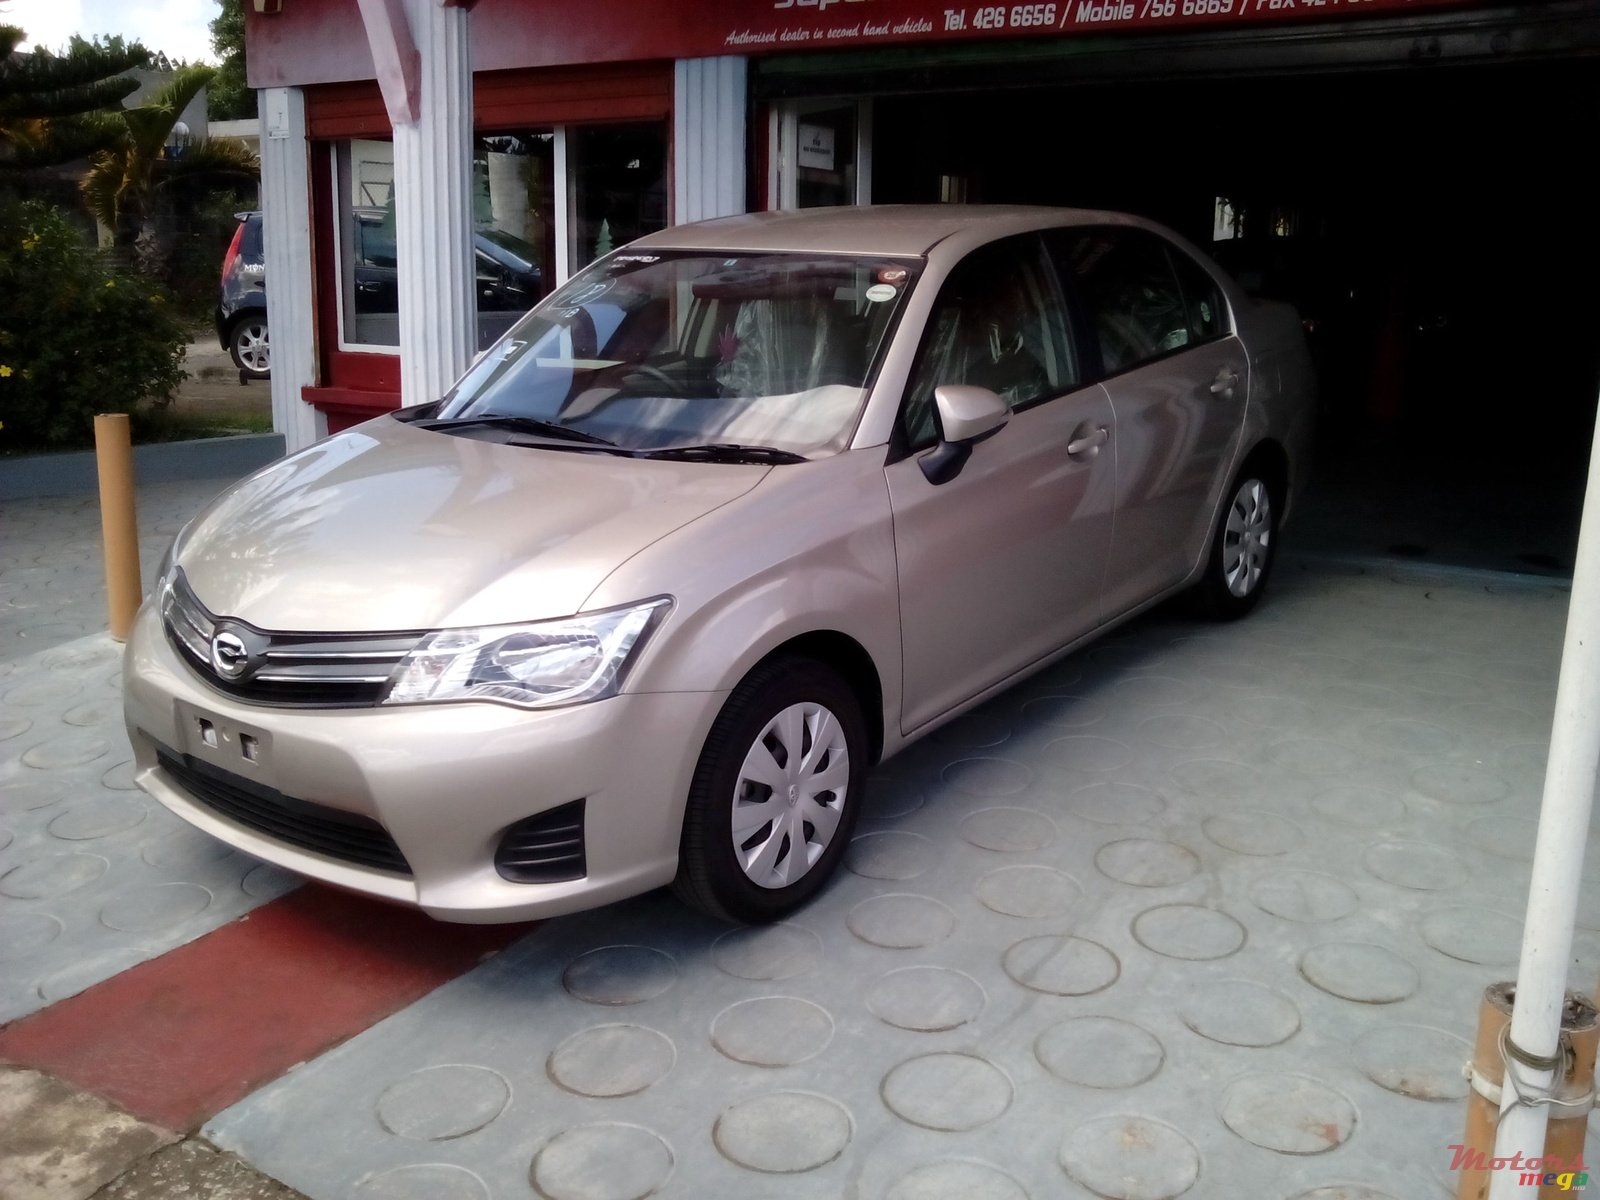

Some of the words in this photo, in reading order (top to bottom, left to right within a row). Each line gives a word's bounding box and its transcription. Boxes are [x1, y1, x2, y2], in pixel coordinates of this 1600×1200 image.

[943, 9, 967, 31] Tel.
[972, 6, 1006, 30] 426
[1010, 3, 1057, 27] 6656
[1075, 0, 1136, 23] Mobile
[724, 29, 777, 47] Authorised
[780, 27, 811, 43] dealer
[813, 28, 824, 41] in
[827, 22, 860, 39] second
[862, 20, 891, 36] hand
[892, 17, 934, 34] vehicles
